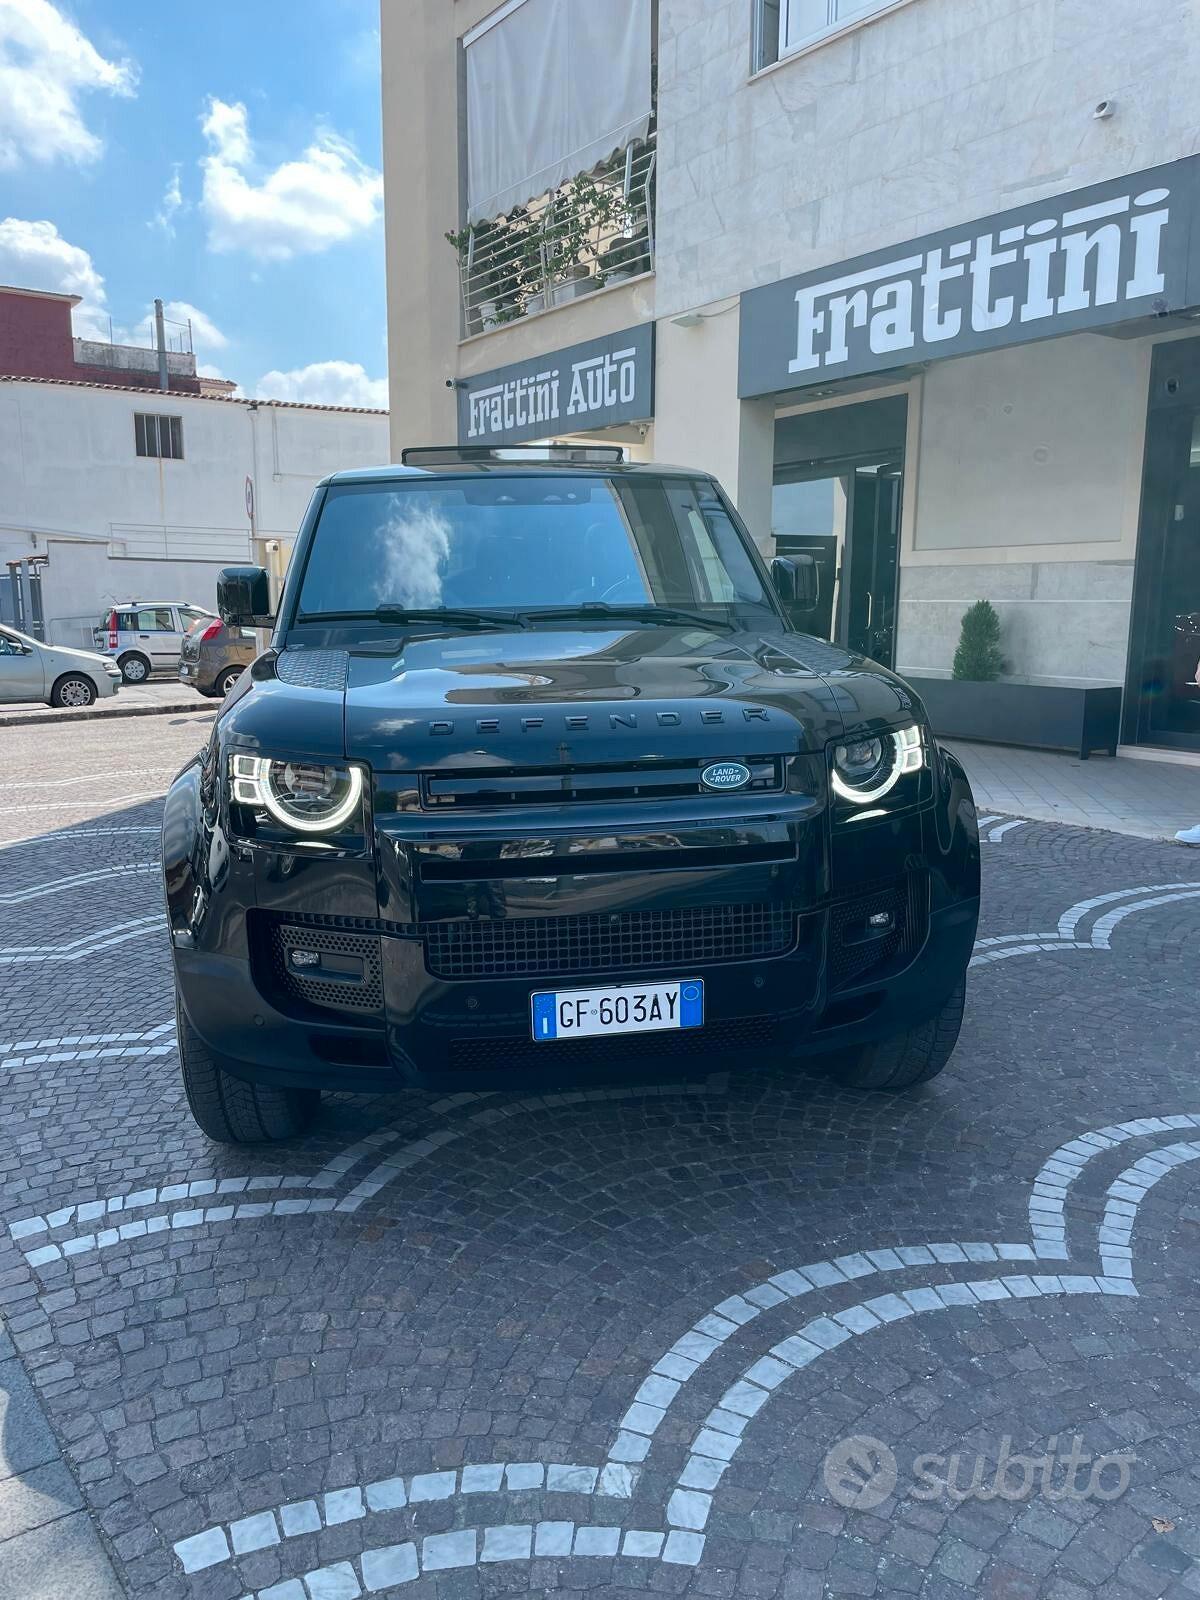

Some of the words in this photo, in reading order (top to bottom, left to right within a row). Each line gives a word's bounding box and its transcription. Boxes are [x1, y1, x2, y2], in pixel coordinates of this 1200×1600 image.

[788, 188, 1170, 374] Frattini
[468, 369, 560, 437] Frattini
[566, 347, 636, 415] Auto
[428, 708, 770, 736] DEFENDER
